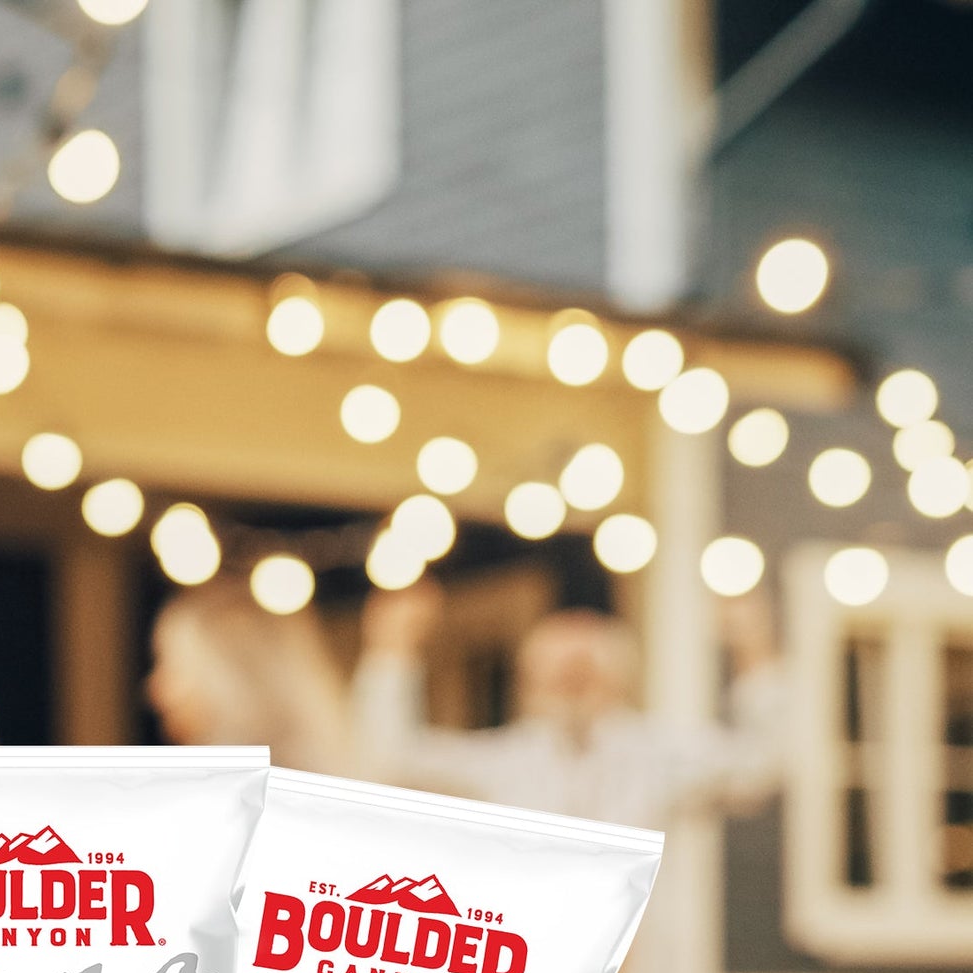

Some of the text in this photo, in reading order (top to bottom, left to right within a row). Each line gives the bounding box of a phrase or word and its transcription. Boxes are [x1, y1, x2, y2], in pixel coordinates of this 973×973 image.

[87, 852, 125, 865] 1994
[308, 880, 341, 897] EST.
[467, 907, 505, 926] 1994
